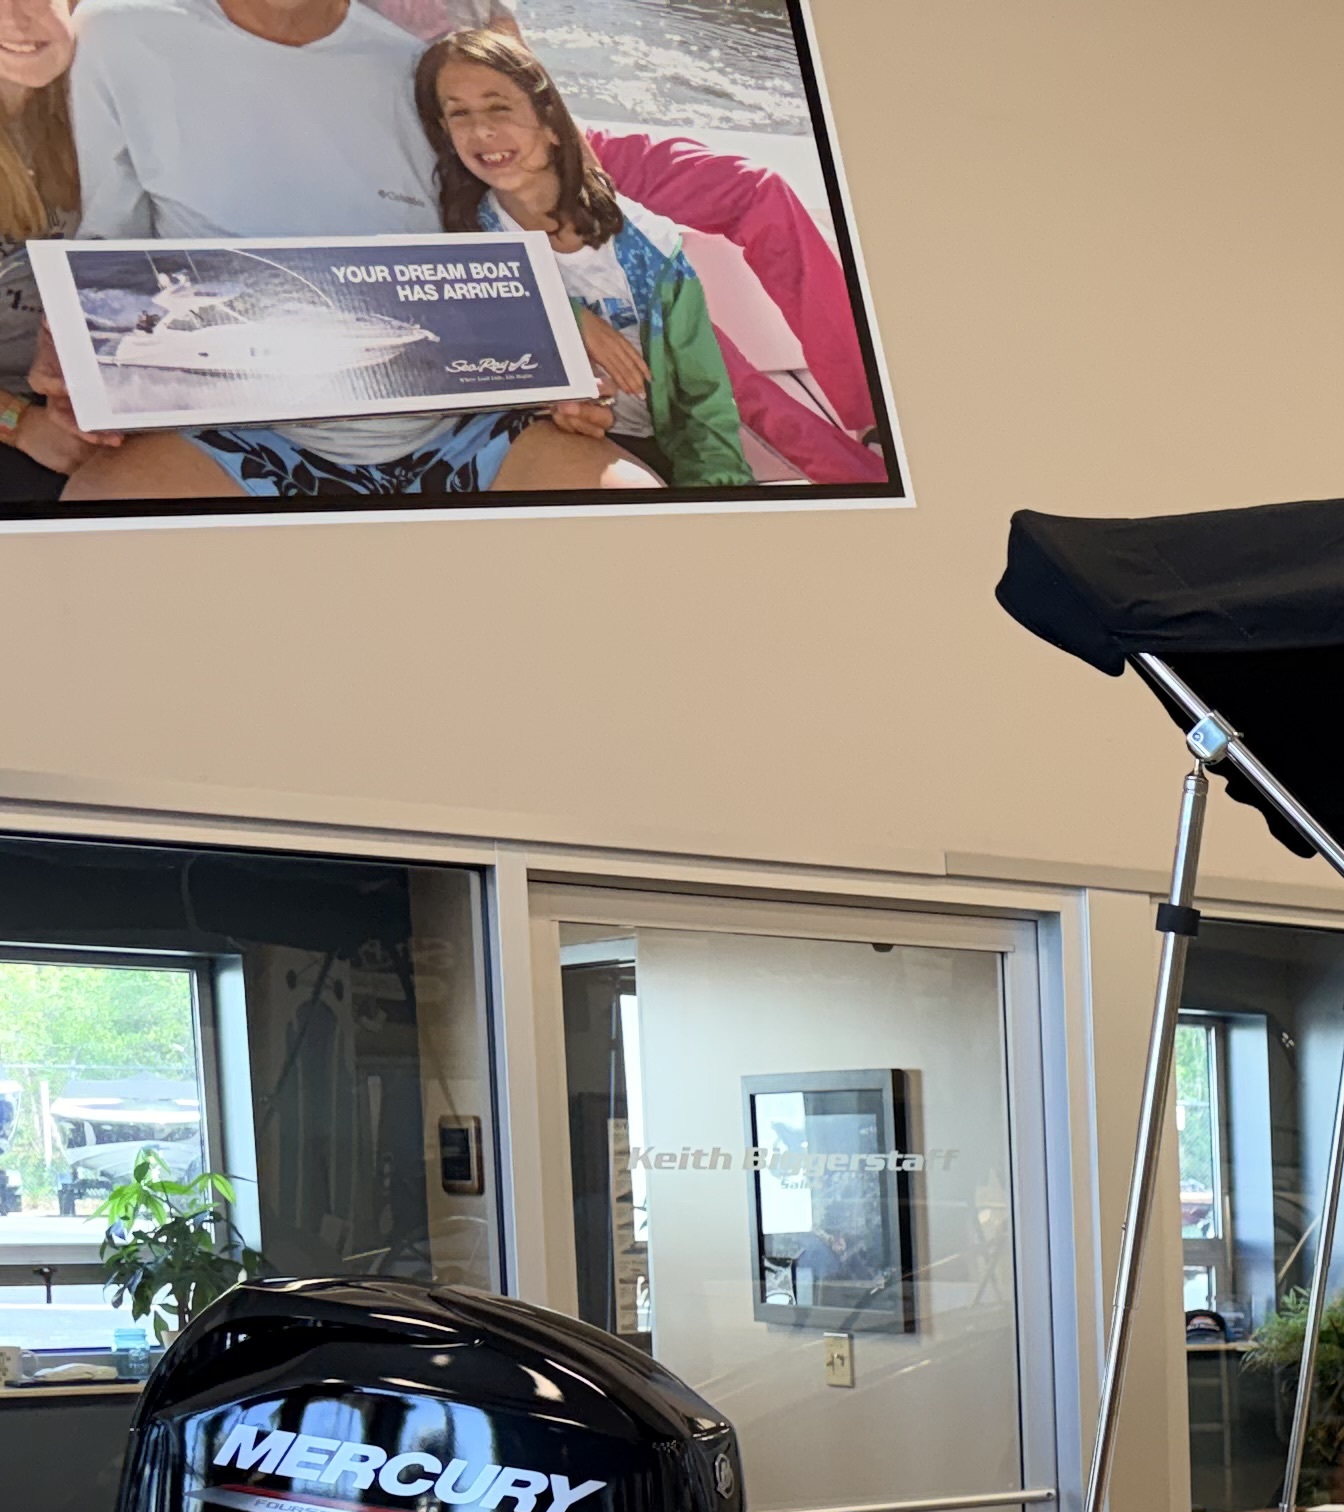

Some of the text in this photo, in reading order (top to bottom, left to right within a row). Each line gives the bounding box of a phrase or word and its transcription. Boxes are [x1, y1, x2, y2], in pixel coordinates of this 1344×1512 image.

[331, 261, 520, 284] YOUR DREAM BOAT
[396, 281, 530, 302] HAS ARRIVED.
[626, 1146, 733, 1171] Keith
